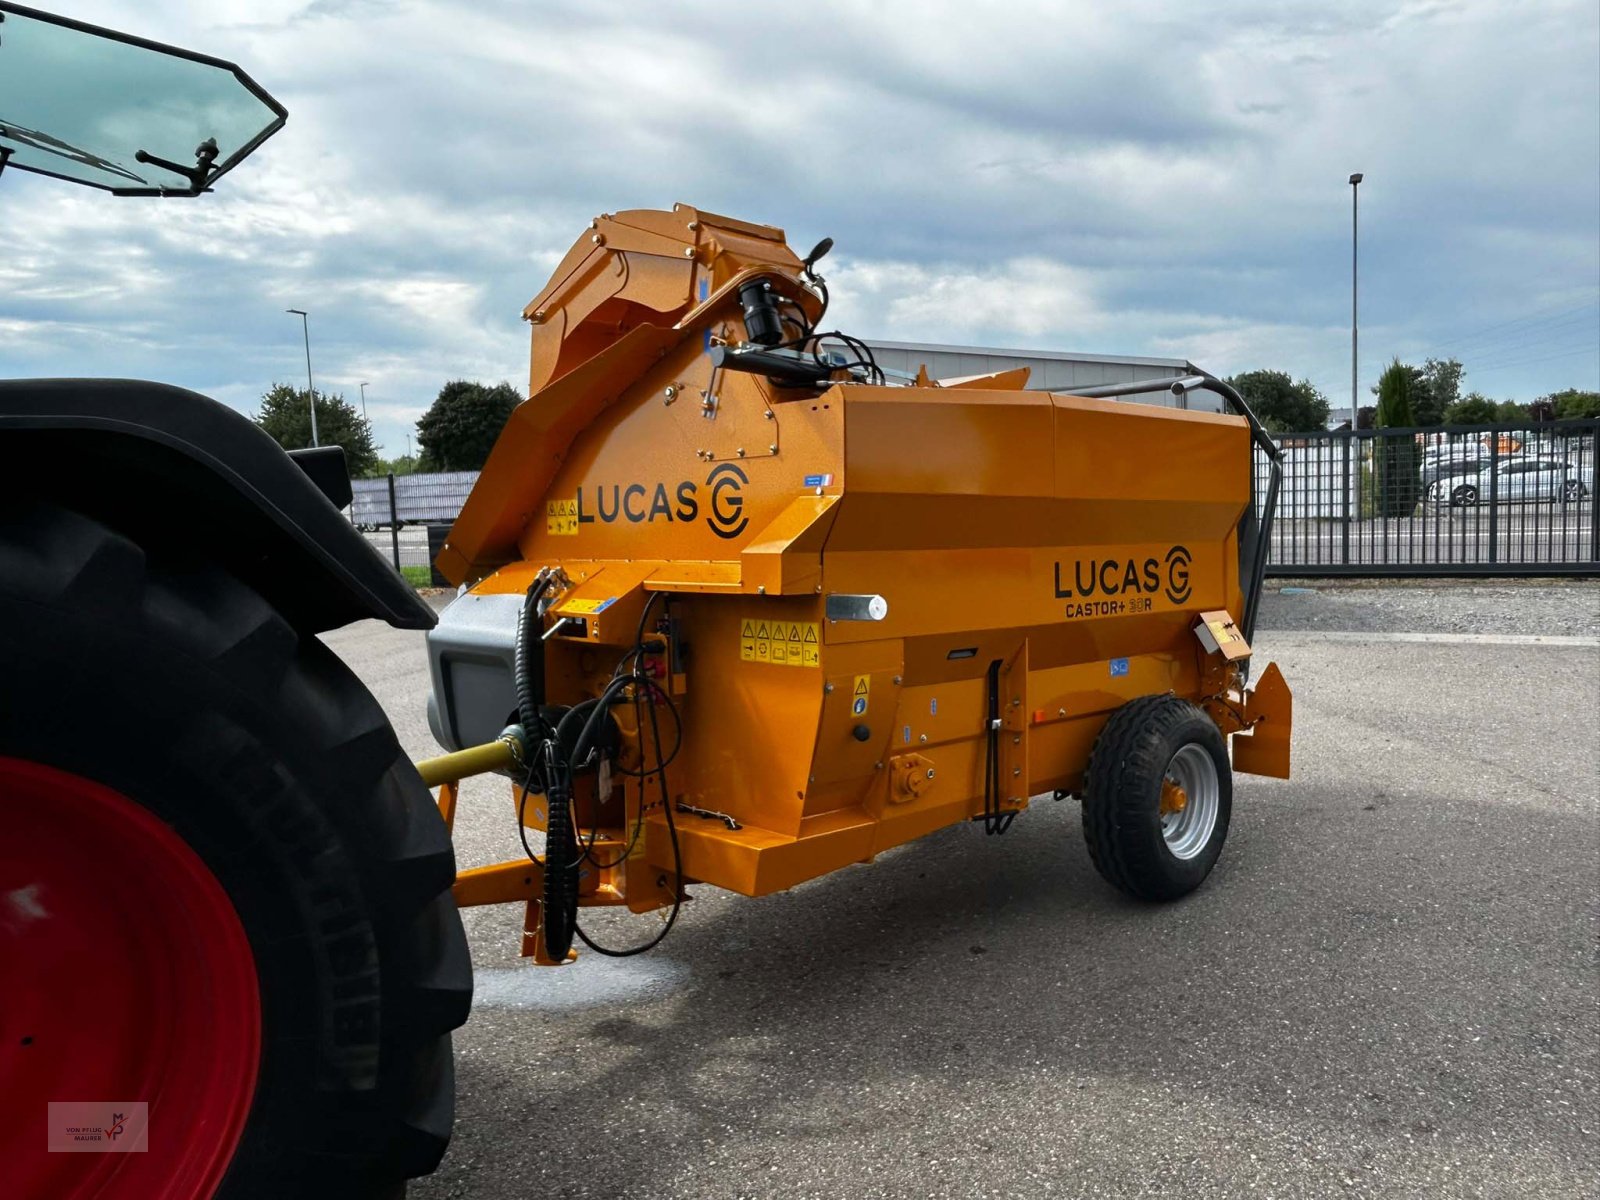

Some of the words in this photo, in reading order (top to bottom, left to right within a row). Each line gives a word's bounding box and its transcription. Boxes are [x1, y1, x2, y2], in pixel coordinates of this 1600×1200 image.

[577, 481, 698, 523] LUCAS
[1054, 558, 1160, 598] LUCAS
[1066, 600, 1126, 618] CASTOR+
